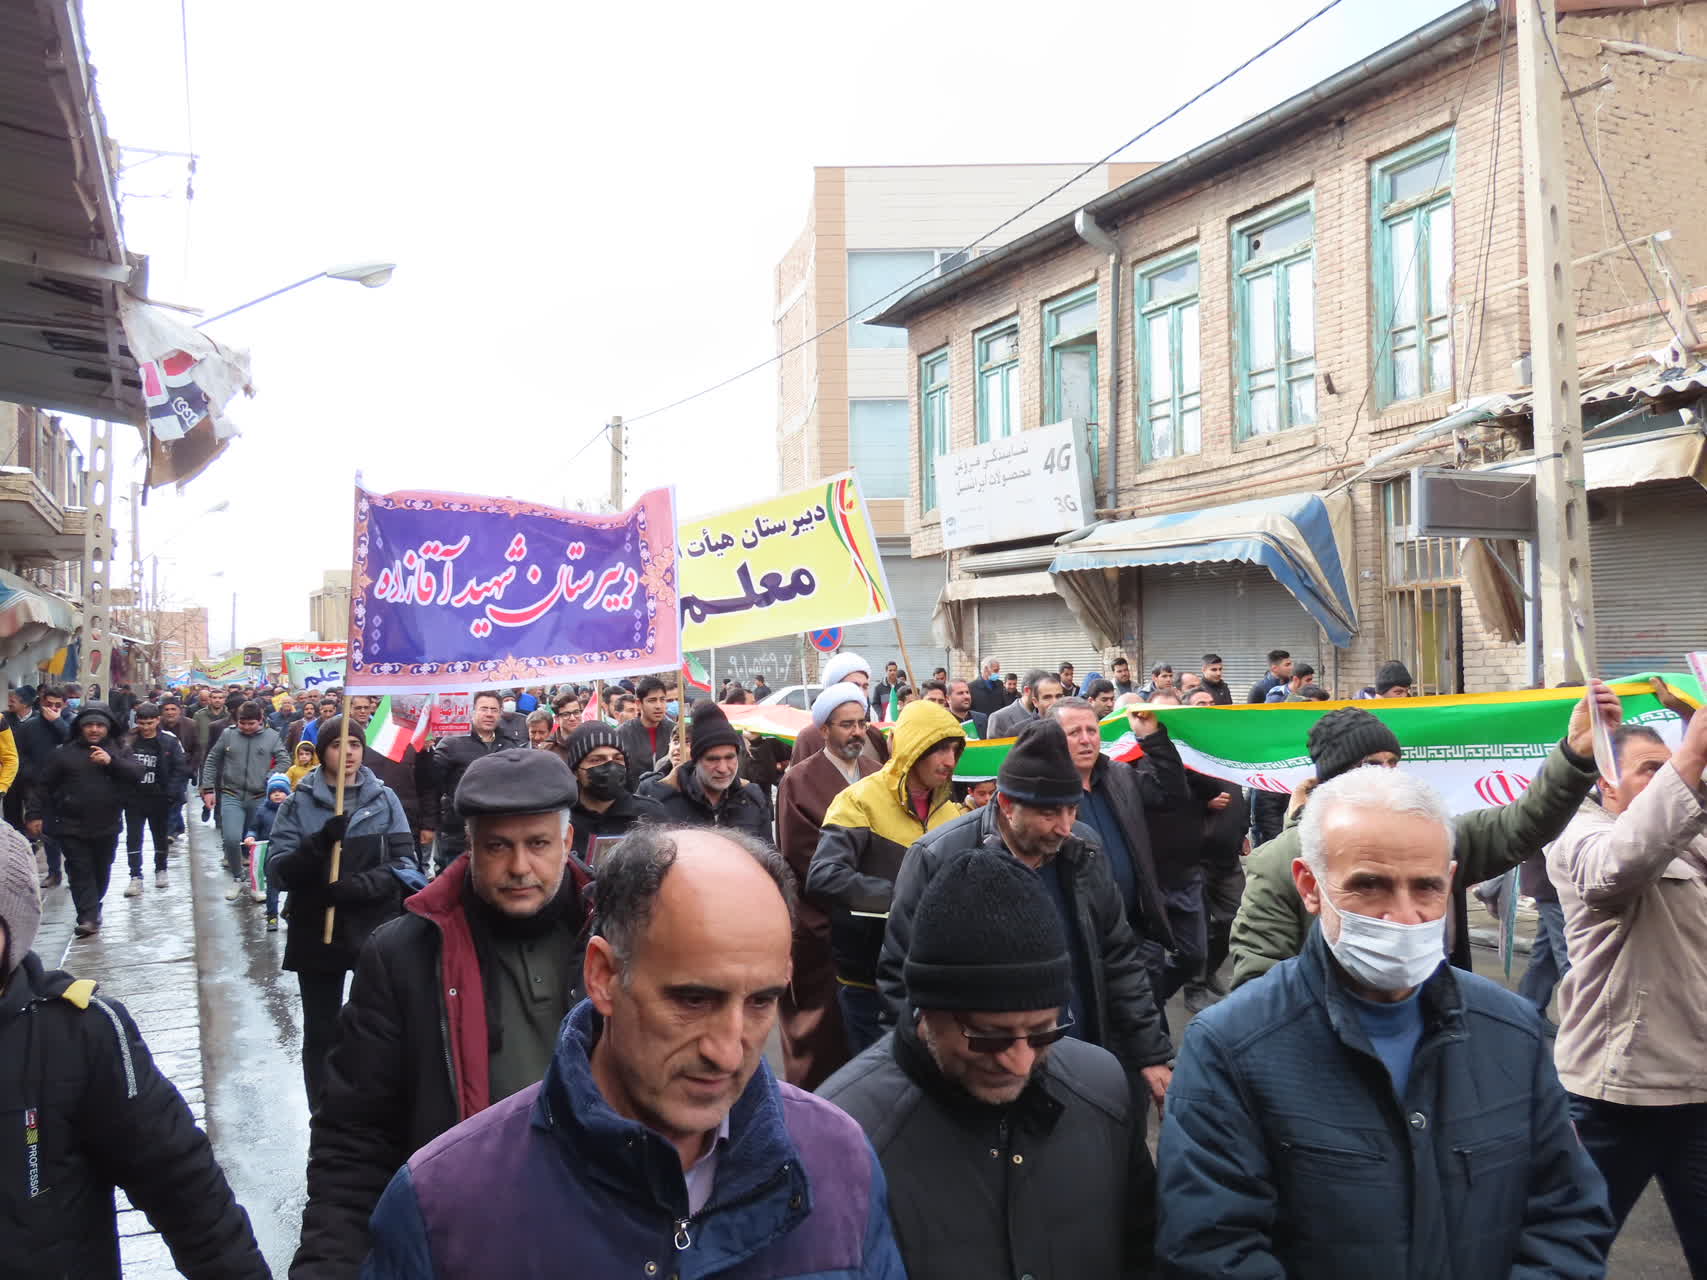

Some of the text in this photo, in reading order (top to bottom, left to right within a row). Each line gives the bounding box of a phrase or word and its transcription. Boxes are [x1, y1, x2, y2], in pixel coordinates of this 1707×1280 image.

[1043, 443, 1072, 474] 4G
[989, 468, 1031, 487] محصولات
[1054, 495, 1079, 512] 3G
[687, 505, 826, 558] دبیرستان هیأت
[374, 533, 639, 638] دبیرستان شهید آقازاده
[304, 668, 340, 688] علم
